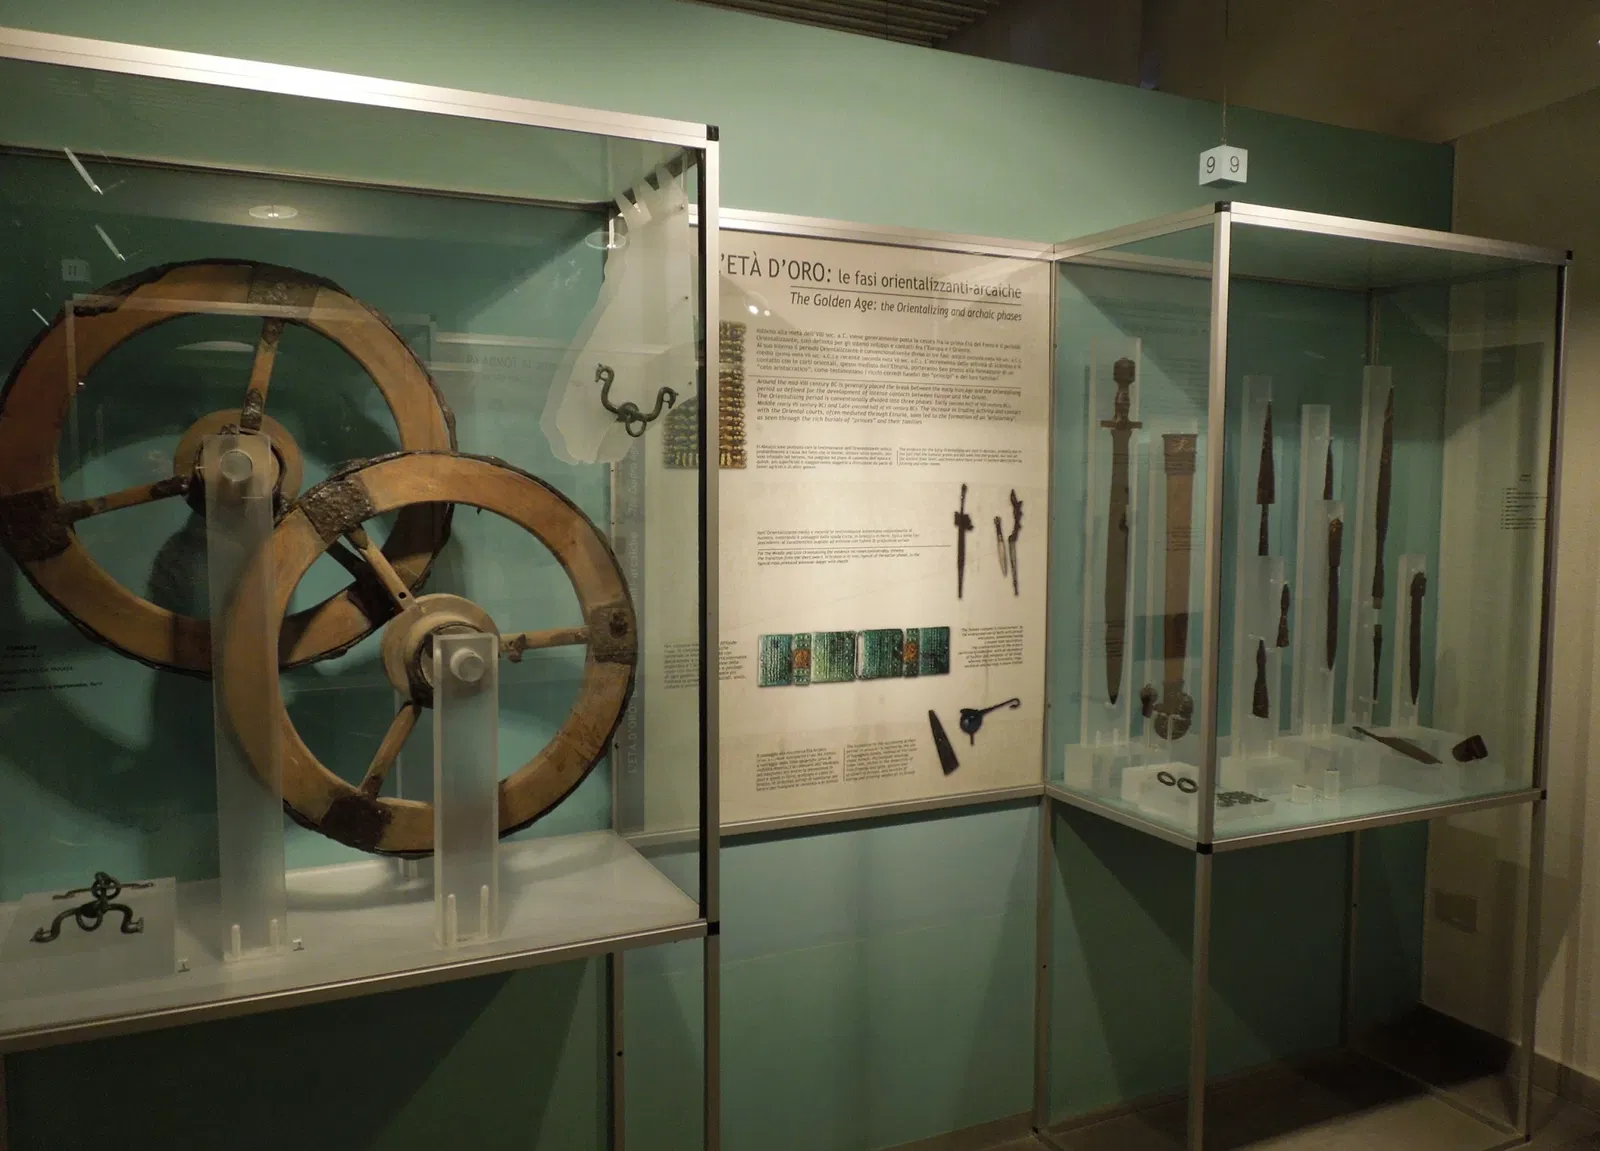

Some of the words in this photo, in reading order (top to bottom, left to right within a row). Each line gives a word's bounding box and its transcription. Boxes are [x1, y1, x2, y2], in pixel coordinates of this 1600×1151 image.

[1207, 156, 1215, 173] 9
[1230, 156, 1239, 172] 9
[719, 251, 762, 277] 'ETÀ
[769, 258, 831, 283] D'ORO:
[839, 269, 850, 284] le
[855, 271, 877, 286] fasi
[881, 273, 1022, 298] orientalizzanti-arcaiche
[791, 292, 810, 305] The
[814, 293, 850, 308] Golden
[854, 297, 877, 312] Age:
[881, 301, 894, 312] the
[897, 302, 949, 318] Orientalizing
[951, 307, 966, 318] and
[967, 308, 994, 320] archaic
[997, 311, 1022, 322] phases
